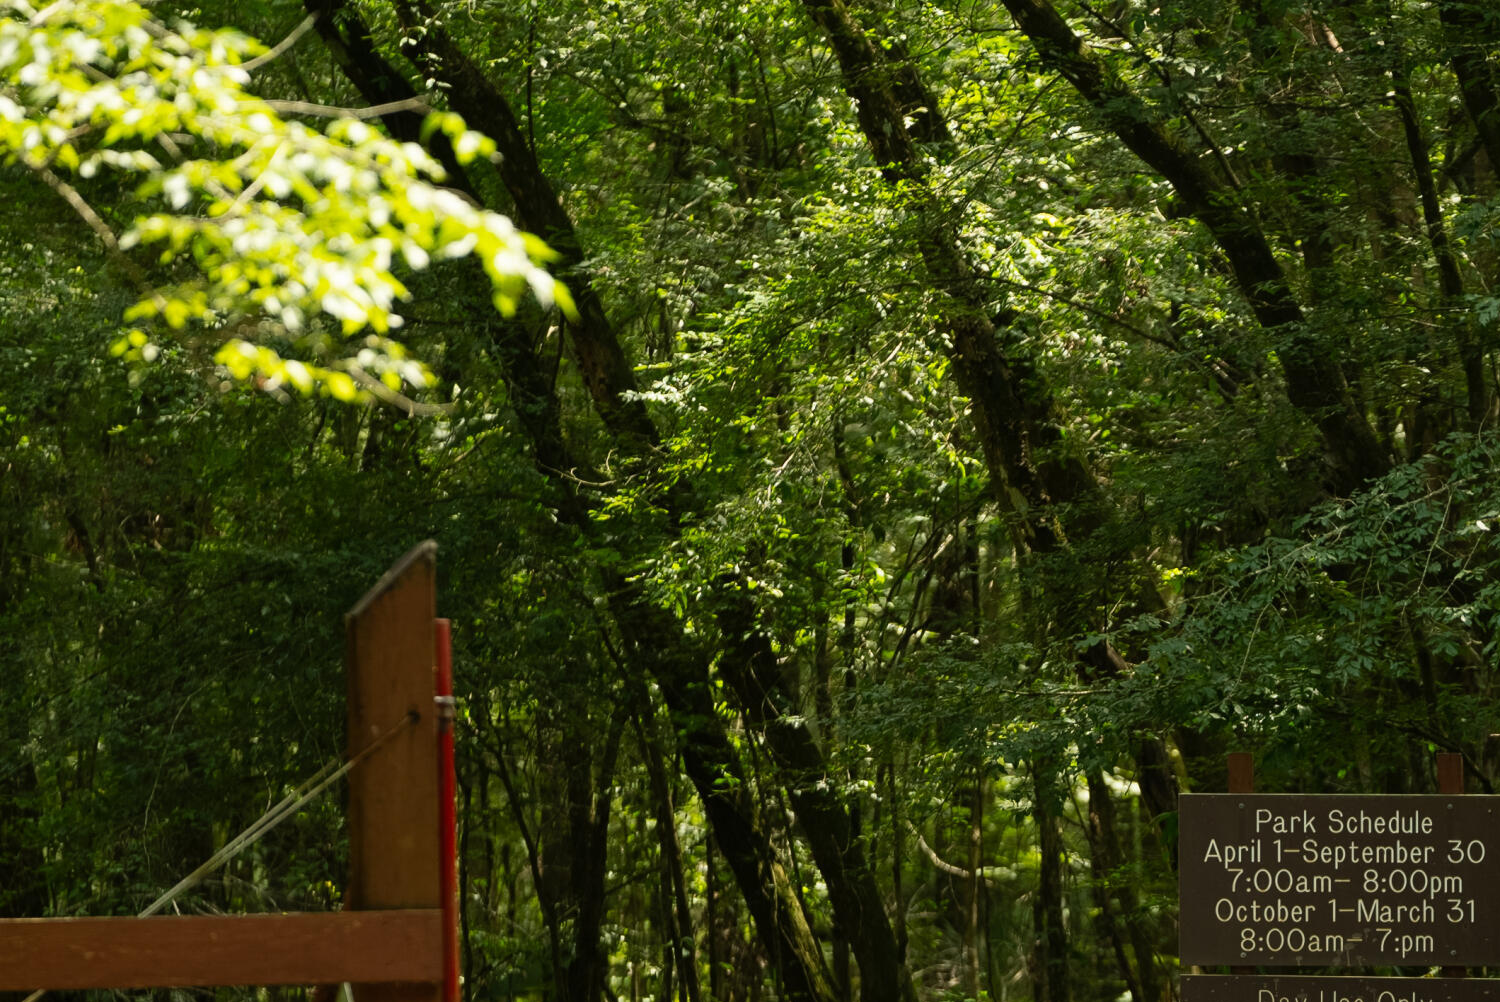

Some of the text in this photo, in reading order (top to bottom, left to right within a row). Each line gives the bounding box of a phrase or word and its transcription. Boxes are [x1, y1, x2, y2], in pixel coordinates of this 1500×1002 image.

[1255, 808, 1433, 834] Park Schedule
[1203, 838, 1262, 869] April
[1447, 839, 1486, 864] 30
[1362, 869, 1463, 899] 8:00pm
[1215, 898, 1316, 923] October
[1446, 899, 1475, 923] 31
[1375, 928, 1434, 959] 7:pm
